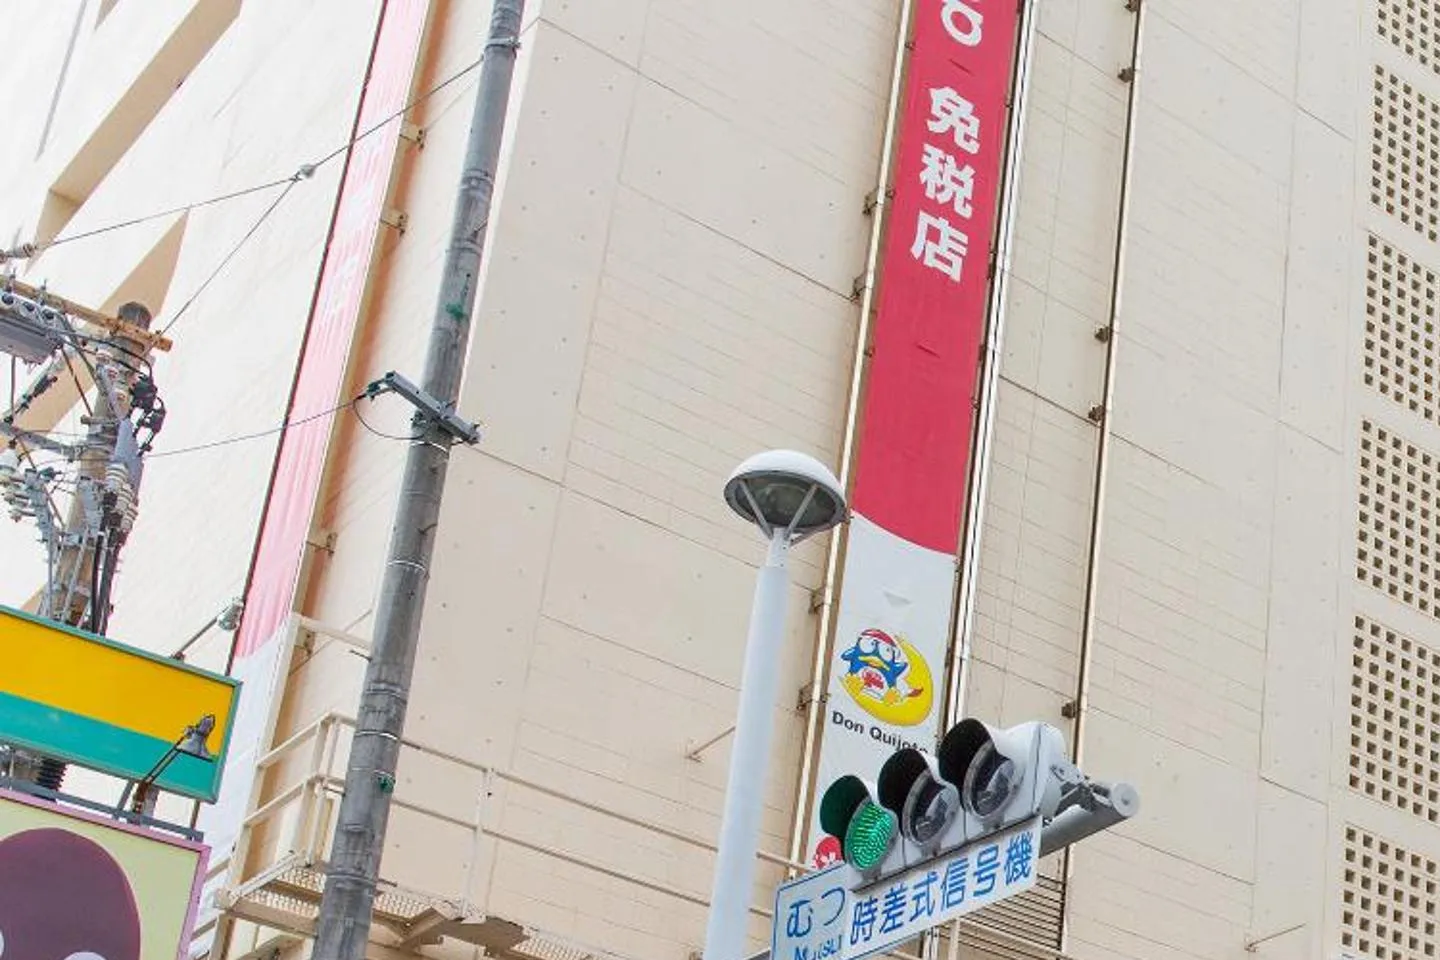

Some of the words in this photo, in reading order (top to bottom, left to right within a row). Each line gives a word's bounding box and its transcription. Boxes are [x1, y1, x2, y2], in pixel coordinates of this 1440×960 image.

[910, 86, 981, 283] 免税店
[832, 710, 864, 735] Don
[850, 831, 1034, 945] 時差式信号機
